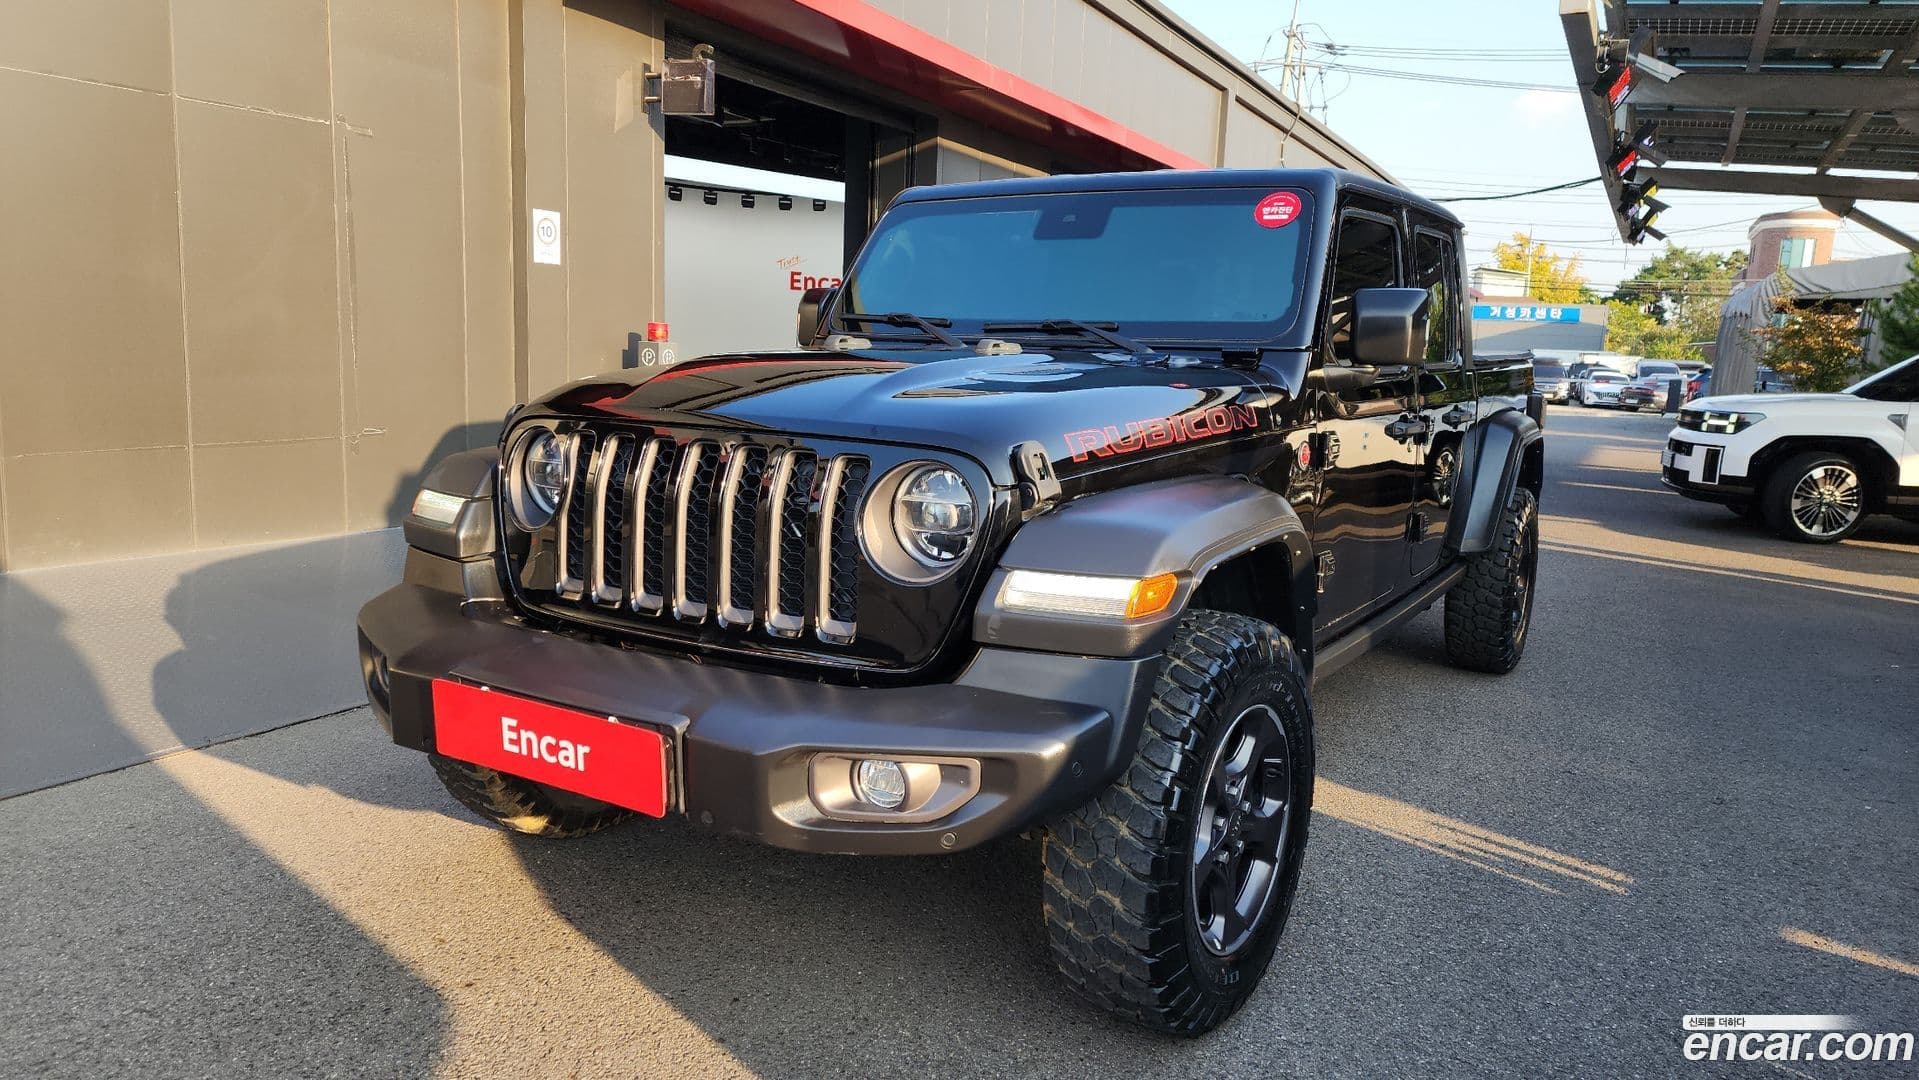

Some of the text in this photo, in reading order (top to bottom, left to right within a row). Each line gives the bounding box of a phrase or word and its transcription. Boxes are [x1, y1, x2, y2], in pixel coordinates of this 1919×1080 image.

[541, 225, 553, 238] 10
[1064, 404, 1258, 463] RUBICON
[501, 716, 591, 772] Encar
